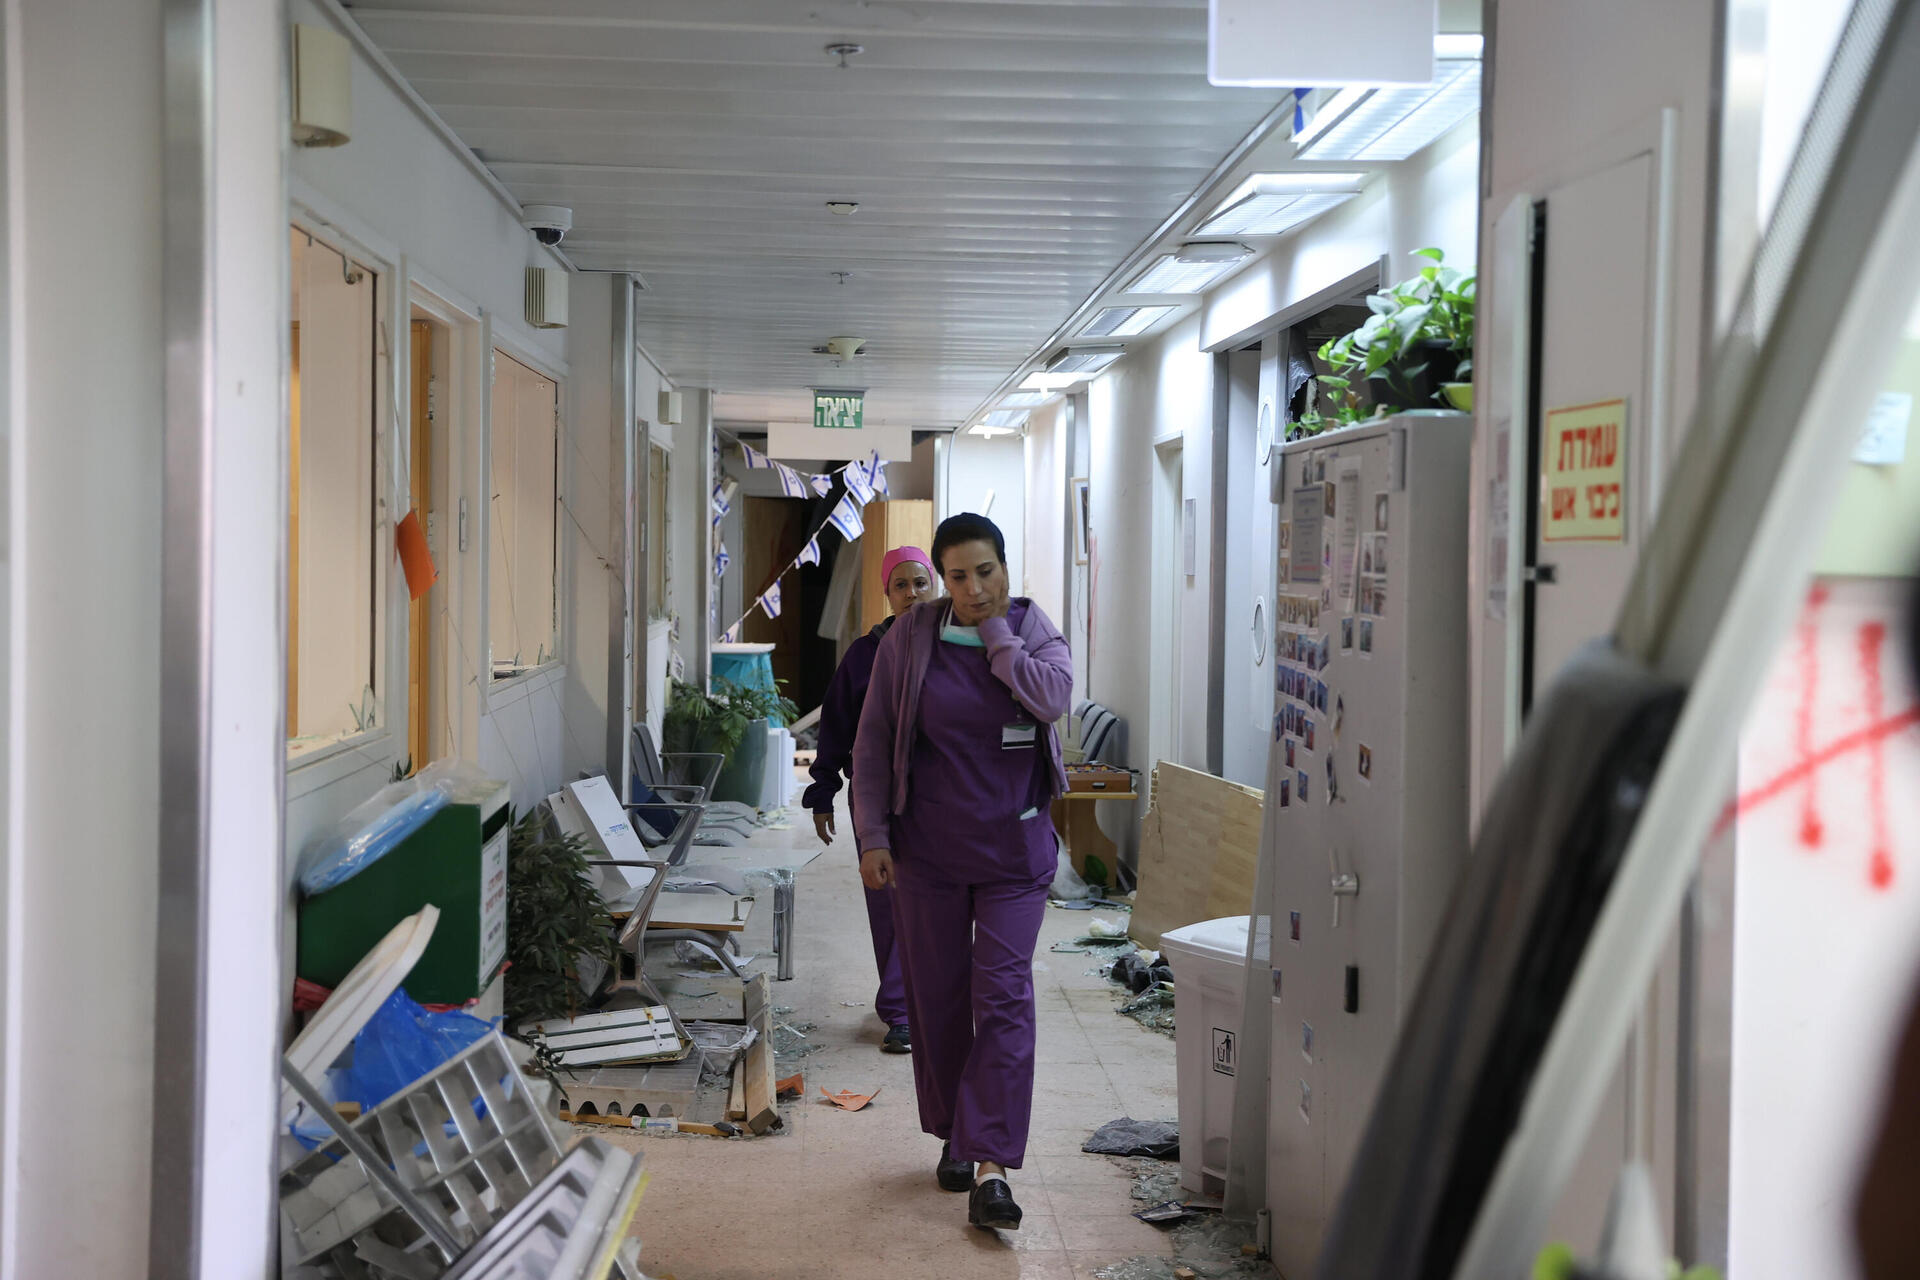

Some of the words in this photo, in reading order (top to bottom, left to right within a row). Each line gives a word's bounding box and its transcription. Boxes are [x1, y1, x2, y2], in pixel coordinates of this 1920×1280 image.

[816, 397, 862, 427] יציאה
[1558, 424, 1617, 471] עמדת
[1552, 487, 1576, 520] אש
